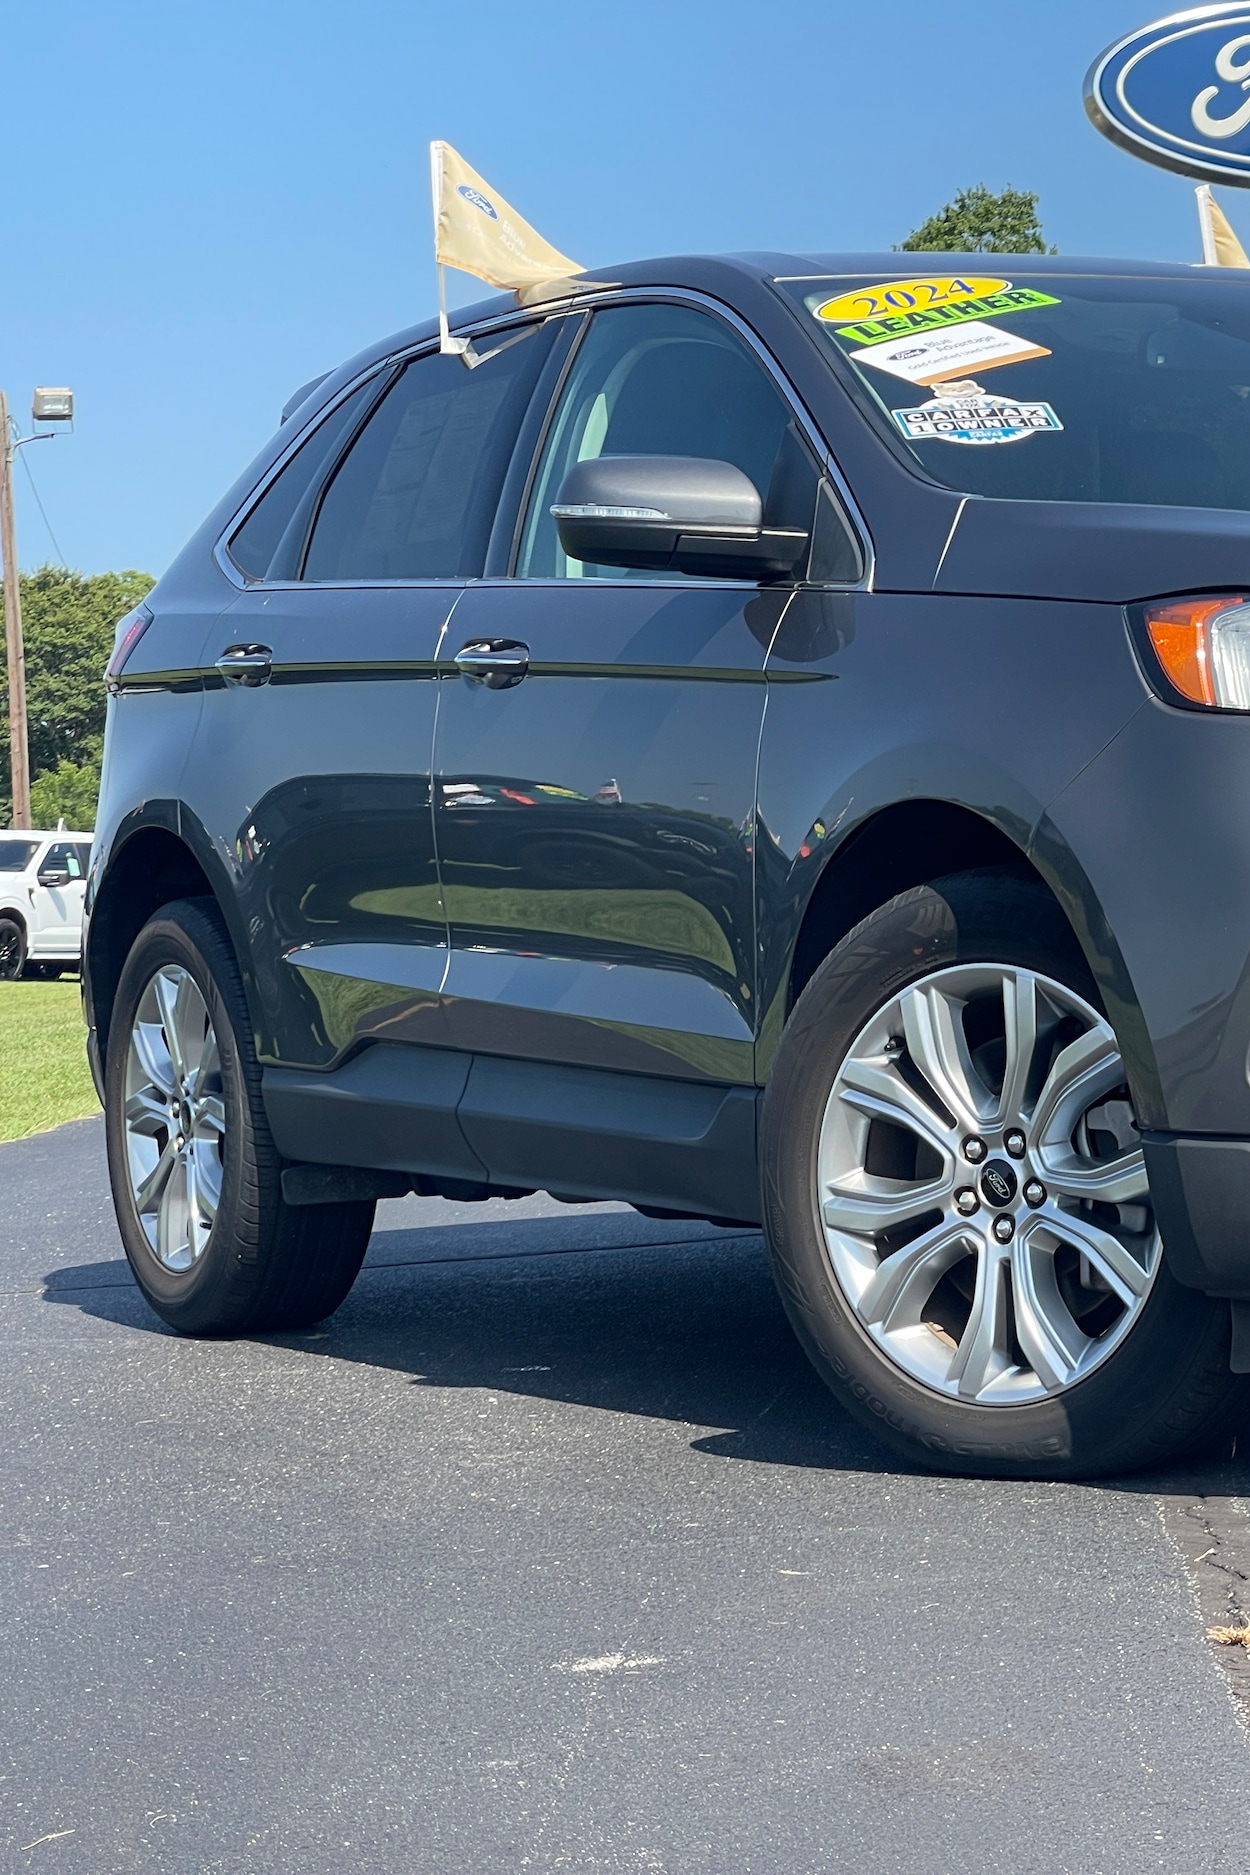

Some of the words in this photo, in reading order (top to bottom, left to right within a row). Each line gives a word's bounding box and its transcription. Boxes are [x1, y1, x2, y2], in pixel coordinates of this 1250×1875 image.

[852, 279, 975, 318] 2024
[852, 289, 1038, 339] LEATHER
[923, 337, 953, 349] Blue
[905, 406, 1045, 423] CARFAX
[911, 424, 930, 434] 1
[935, 417, 1050, 432] OWNER
[988, 1172, 1007, 1195] Ford
